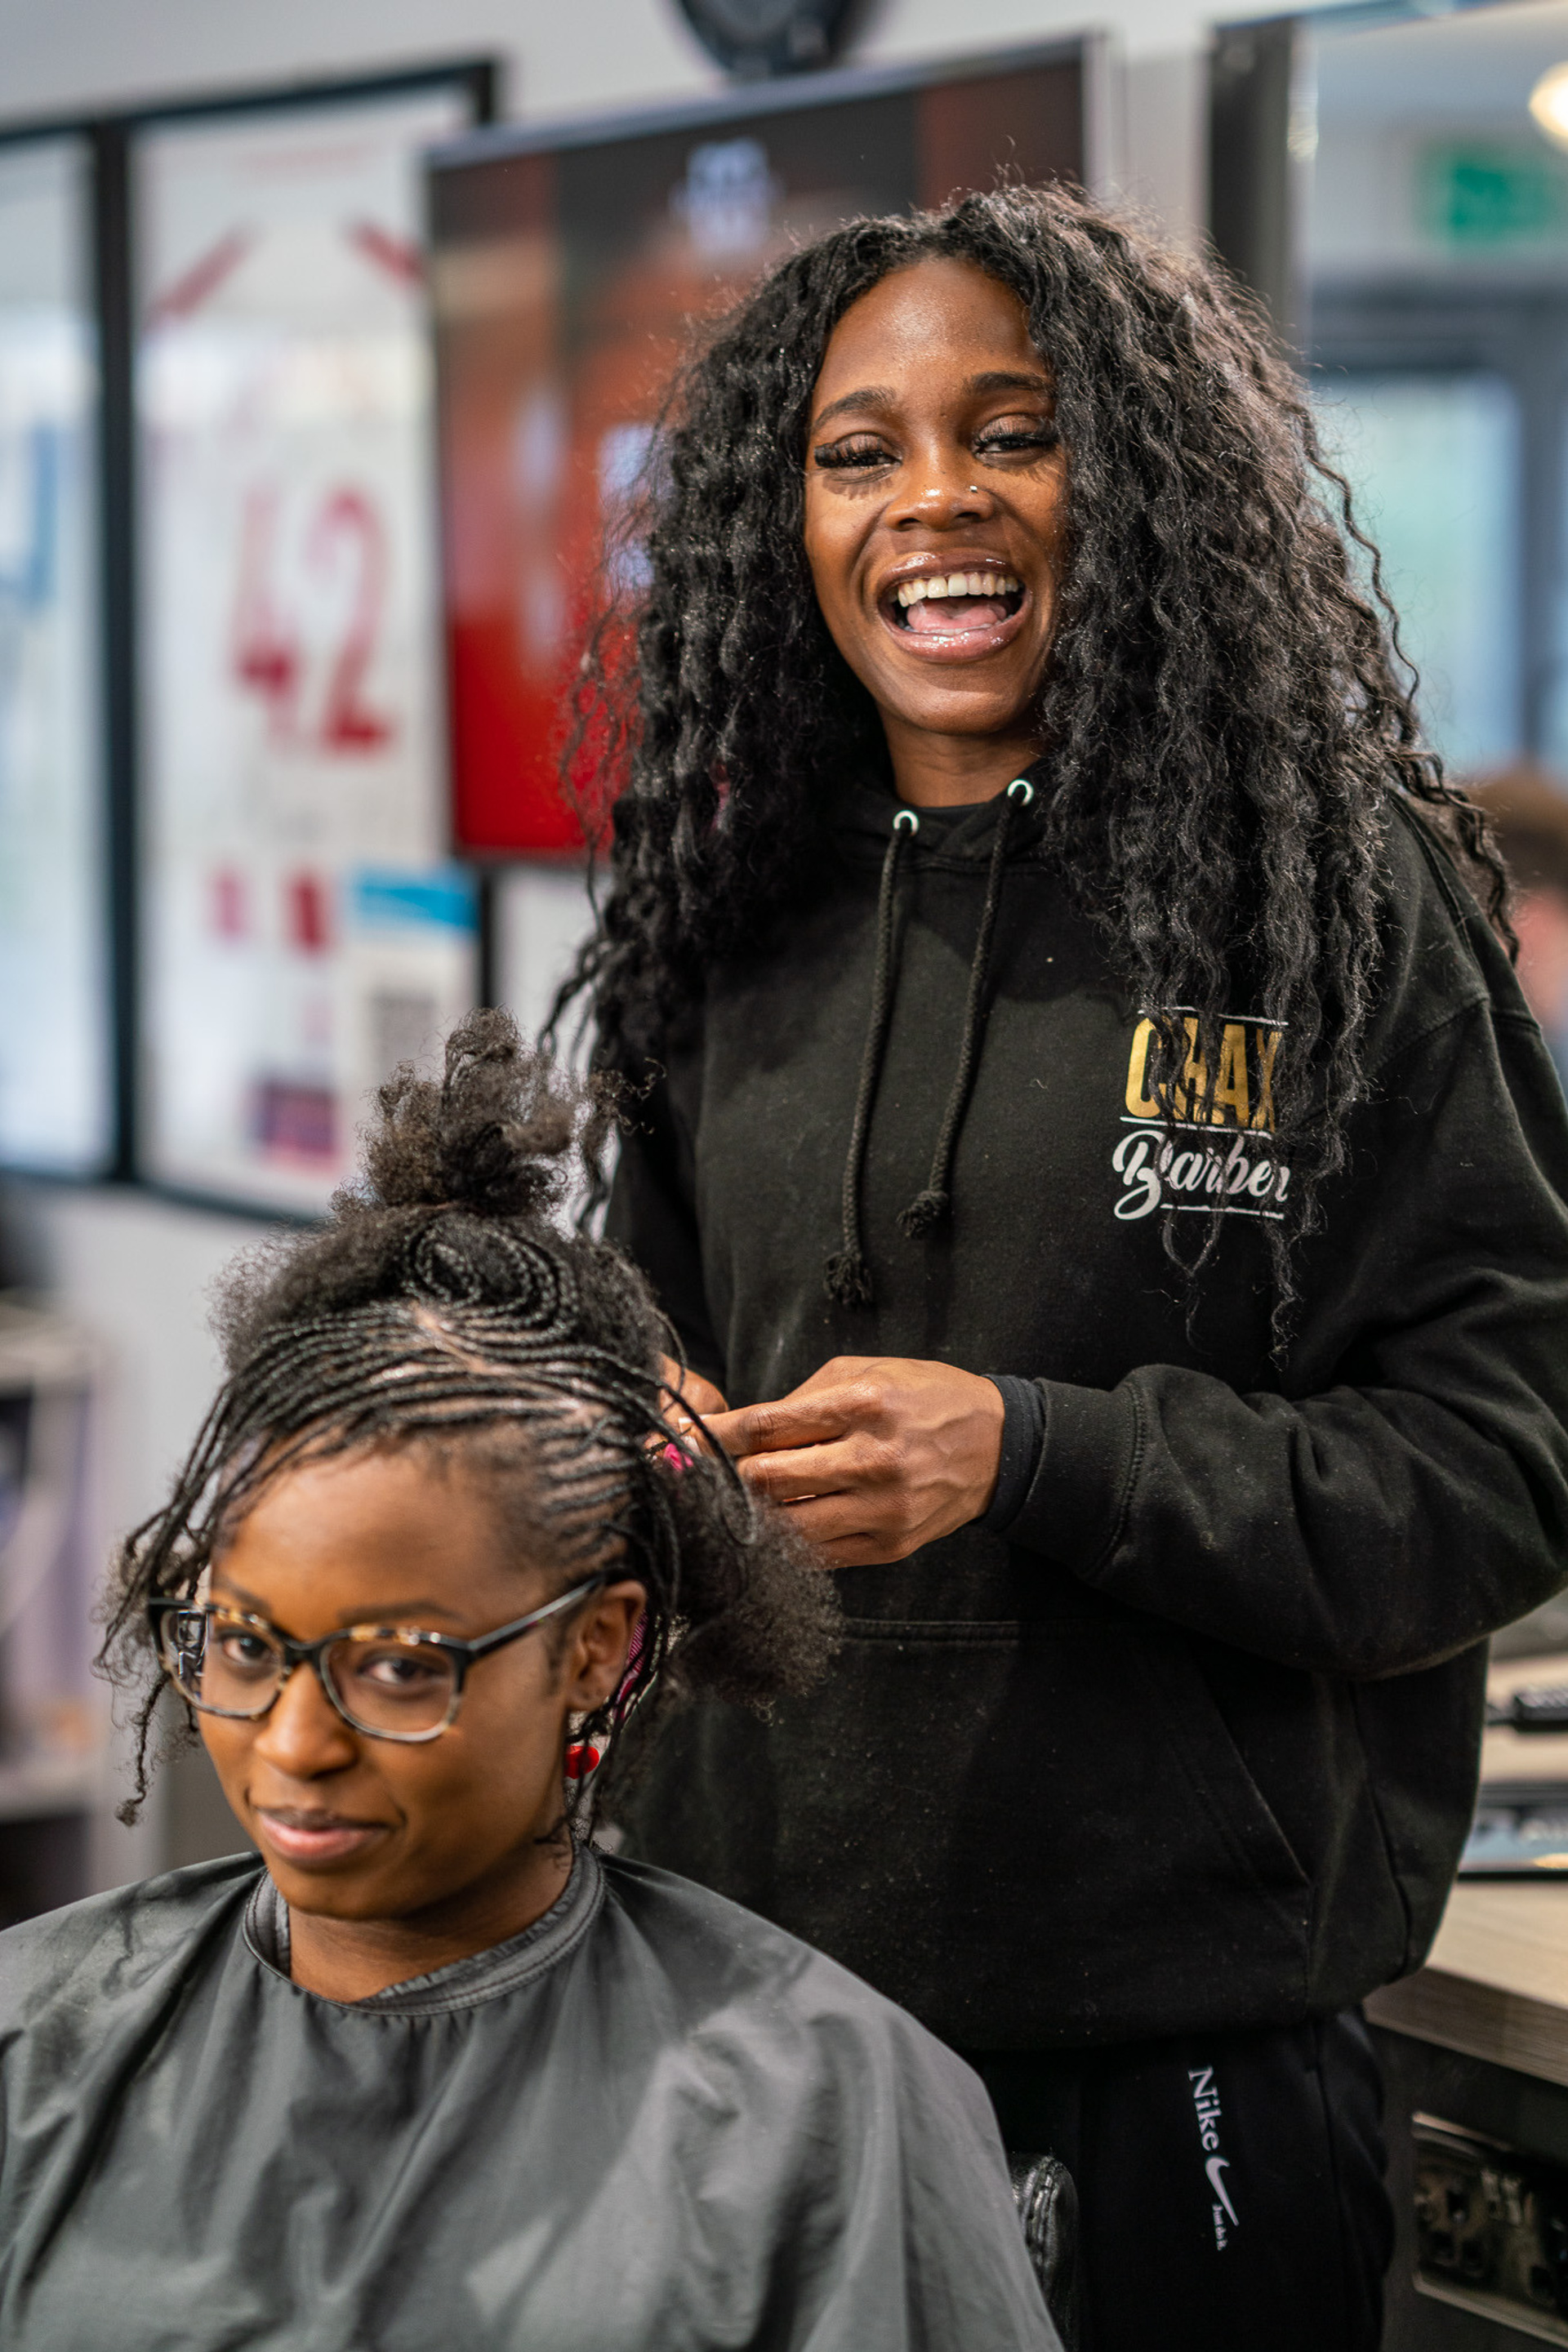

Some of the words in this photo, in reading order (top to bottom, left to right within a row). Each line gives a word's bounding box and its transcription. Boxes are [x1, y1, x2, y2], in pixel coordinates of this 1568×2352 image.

[1111, 1129, 1290, 1220] Barber
[1188, 2065, 1222, 2151] Nike
[1212, 2204, 1223, 2225] Just
[1215, 2226, 1226, 2239] do
